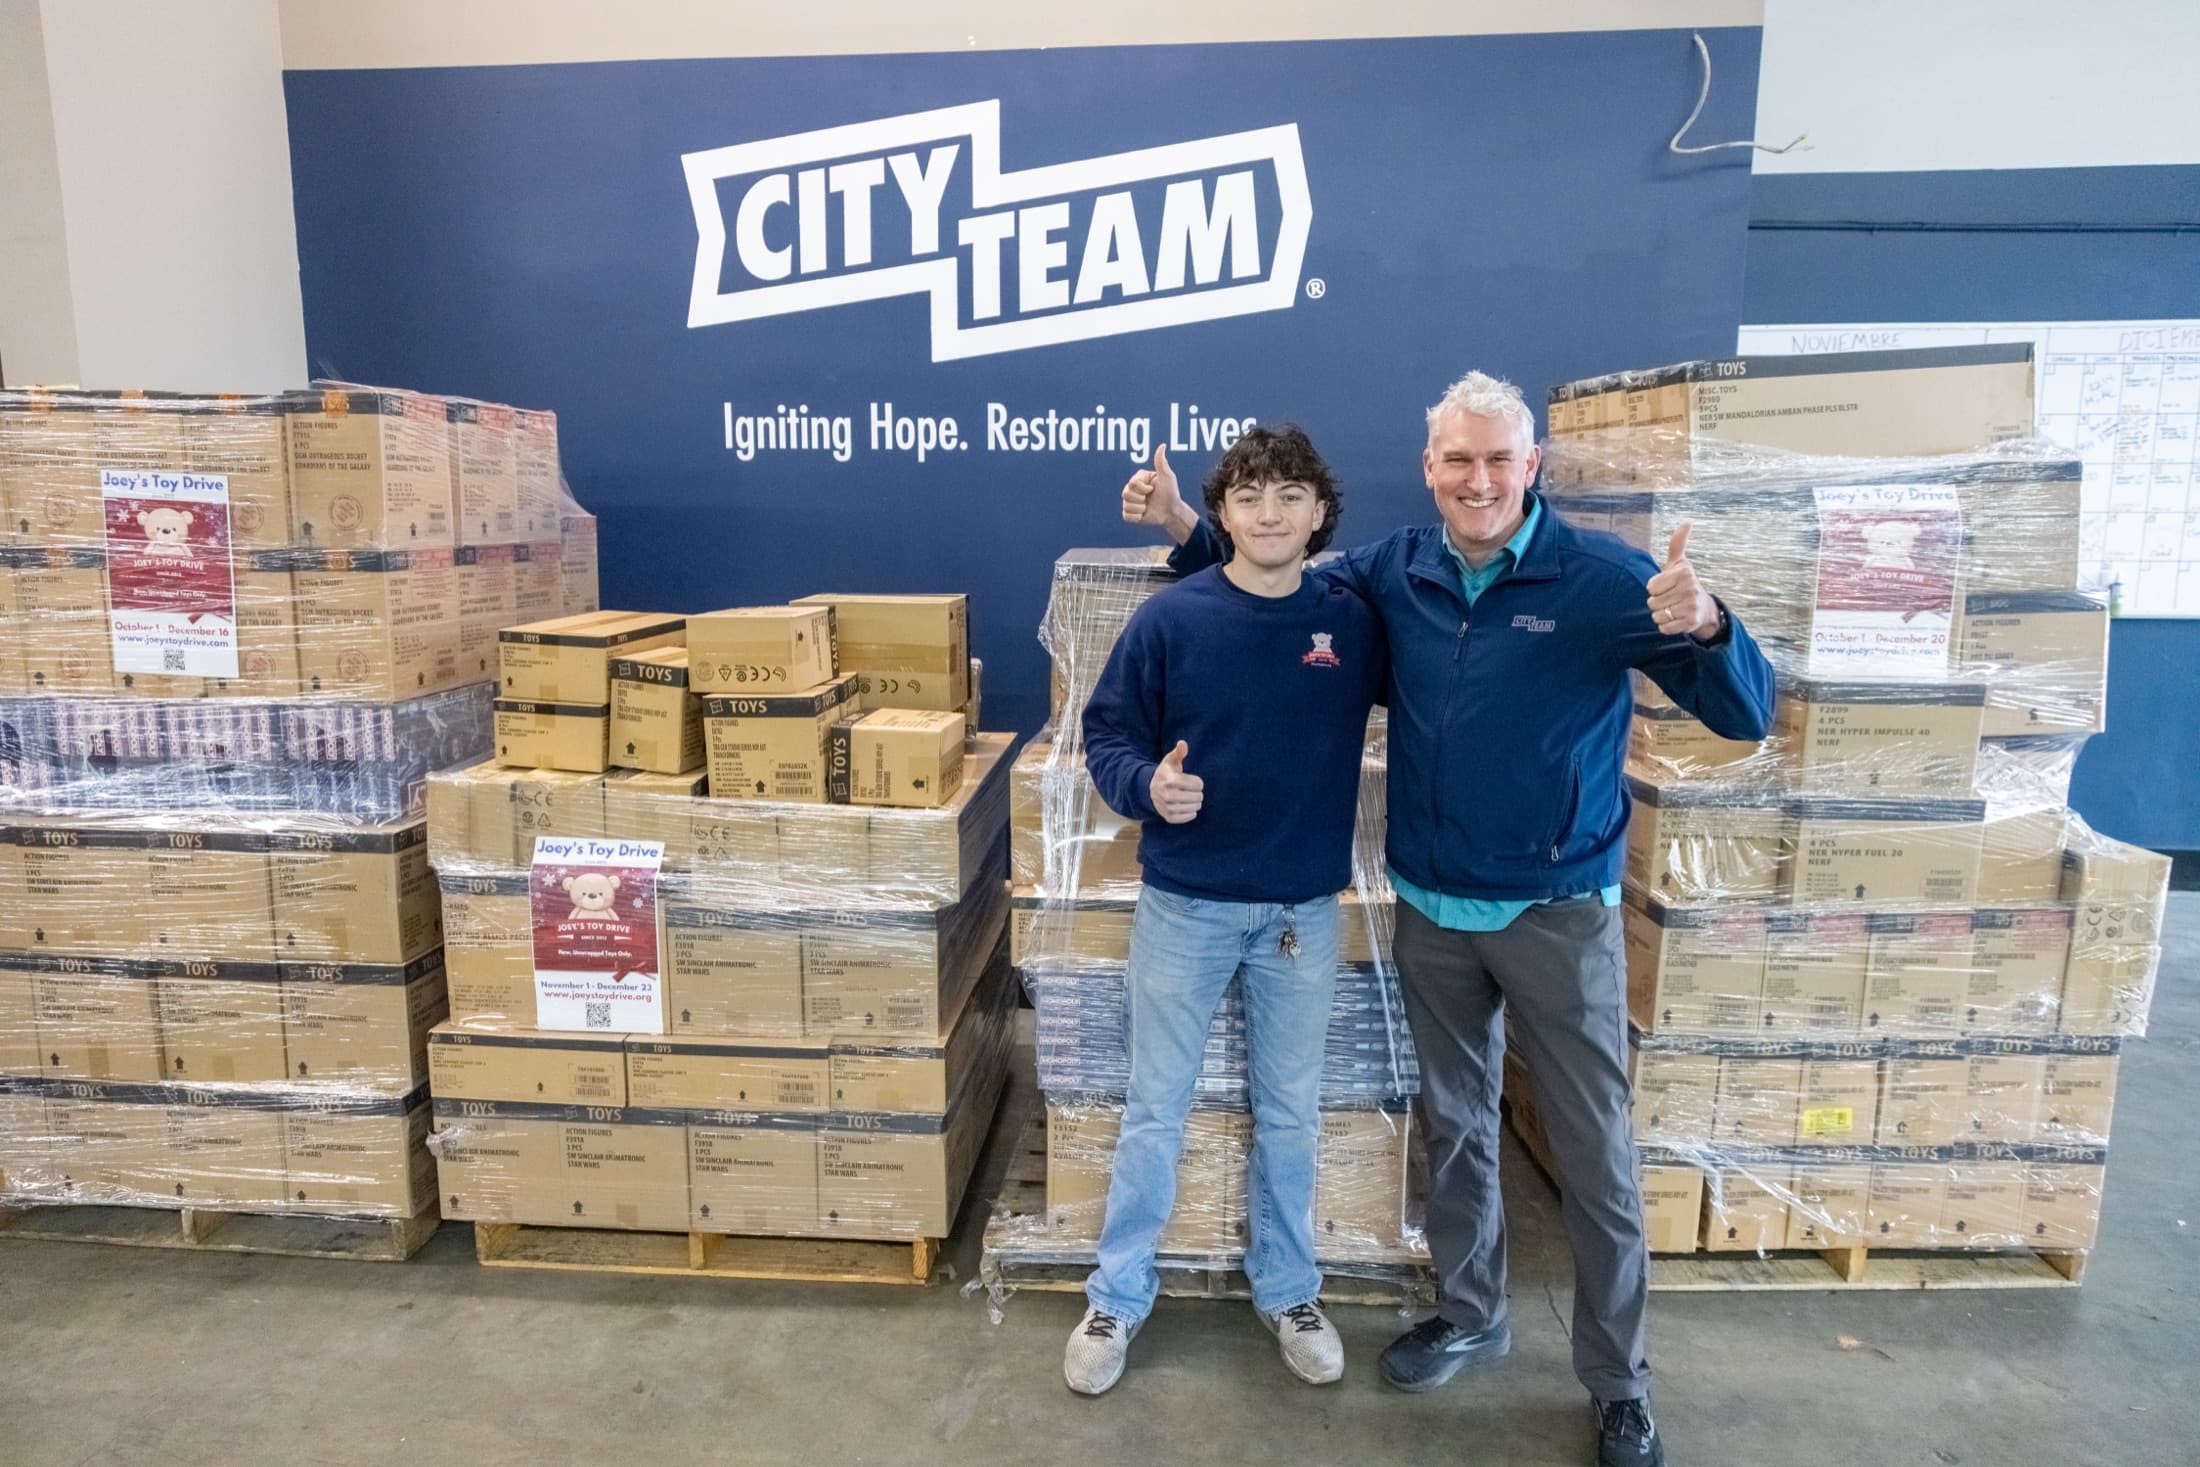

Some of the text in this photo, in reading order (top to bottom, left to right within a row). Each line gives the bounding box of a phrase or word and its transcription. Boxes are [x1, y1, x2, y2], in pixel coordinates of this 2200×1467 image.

[735, 143, 961, 282] CITY
[957, 169, 1262, 321] TEAM
[1717, 361, 1746, 376] TOYS
[1719, 385, 1737, 394] TOYS
[1725, 409, 1776, 420] MANDALORIAN
[1777, 407, 1803, 416] AMBAN
[1803, 406, 1825, 415] PHASE
[723, 402, 852, 462] Igniting
[870, 402, 968, 463] Hope.
[987, 402, 1150, 463] Restoring
[103, 472, 224, 492] Joey's Toy Drive
[162, 558, 179, 568] TOY
[114, 620, 154, 632] October
[167, 622, 216, 637] December
[218, 627, 230, 637] 16
[523, 633, 540, 643] TOYS
[1815, 631, 1859, 643] October
[1874, 632, 1928, 644] December
[1930, 633, 1946, 644] 20
[831, 633, 839, 670] TOYS
[637, 664, 673, 682] TOYS
[518, 703, 536, 712] TOYS
[729, 700, 768, 713] TOYS
[1819, 706, 1849, 714] F2899
[1817, 728, 1836, 736] NER
[1839, 728, 1871, 736] HYPER
[1873, 728, 1916, 736] IMPULSE
[1816, 738, 1841, 746] NERF
[832, 737, 847, 777] TOYS
[43, 831, 78, 845] TOYS
[168, 833, 203, 849] TOYS
[299, 833, 334, 849] TOYS
[537, 839, 659, 859] Joey's Toy Drive
[467, 879, 497, 893] TOYS
[557, 922, 631, 934] JOEY'S TOY DRIVE
[675, 933, 697, 941] ACTION
[604, 950, 618, 958] Toys
[617, 950, 632, 958] Only.
[58, 958, 91, 972] TOYS
[183, 963, 219, 976] TOYS
[714, 960, 757, 969] ANIMATRONIC
[309, 966, 344, 981] TOYS
[692, 968, 710, 976] WARS
[540, 981, 585, 991] November
[596, 982, 638, 992] December
[640, 983, 653, 992] 23
[544, 991, 653, 1003] www.joeystoydrive.org
[1040, 1017, 1079, 1026] MONOPOLY
[453, 1035, 472, 1044] TOYS
[1993, 1039, 2033, 1051] TOYS
[653, 1045, 672, 1053] TOYS
[1753, 1041, 1793, 1054] TOYS
[1834, 1042, 1873, 1056] TOYS
[1918, 1042, 1957, 1055] TOYS
[71, 1083, 104, 1097] TOYS
[185, 1089, 219, 1104] TOYS
[461, 1102, 496, 1115] TOYS
[587, 1107, 622, 1121] TOYS
[716, 1111, 752, 1125] TOYS
[846, 1115, 881, 1129] TOYS
[588, 1128, 613, 1136] FIGURES
[846, 1137, 872, 1145] FIGURES
[577, 1153, 604, 1161] SINCLAIR
[1900, 1147, 1939, 1160] TOYS
[1974, 1146, 2015, 1159] TOYS
[705, 1157, 733, 1165] SINCLAIR
[710, 1165, 729, 1173] WARS
[824, 1169, 840, 1177] STAR
